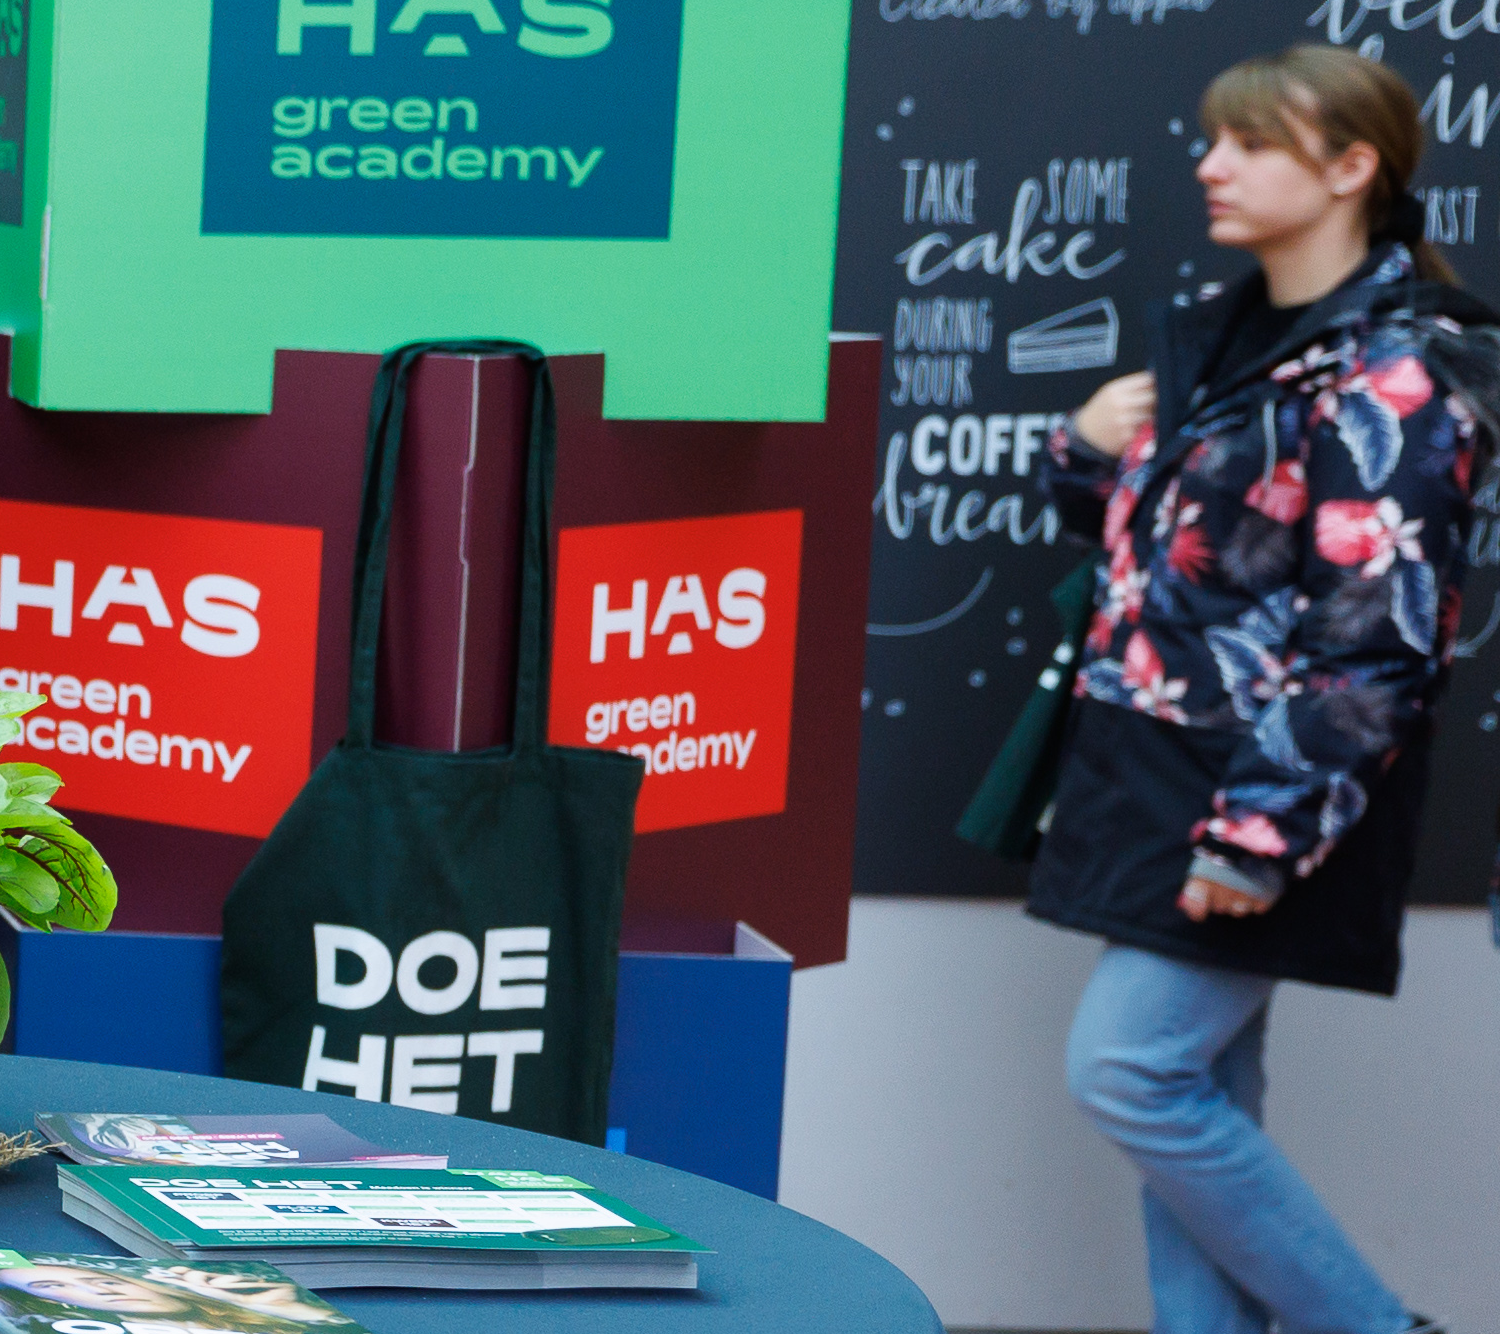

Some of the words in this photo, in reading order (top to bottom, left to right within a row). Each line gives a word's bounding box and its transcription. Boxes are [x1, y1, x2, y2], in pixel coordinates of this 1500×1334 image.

[271, 95, 478, 137] green
[269, 138, 604, 188] academy
[901, 158, 978, 225] TAKE
[1041, 157, 1132, 225] SOME
[894, 178, 1126, 286] cake
[892, 297, 994, 353] DURING
[890, 354, 973, 409] YOUR
[589, 566, 767, 664] HAS
[584, 690, 696, 745] green
[313, 923, 552, 1016] DOE
[301, 1028, 544, 1116] HET
[129, 1177, 248, 1189] DOE
[251, 1179, 364, 1191] HET
